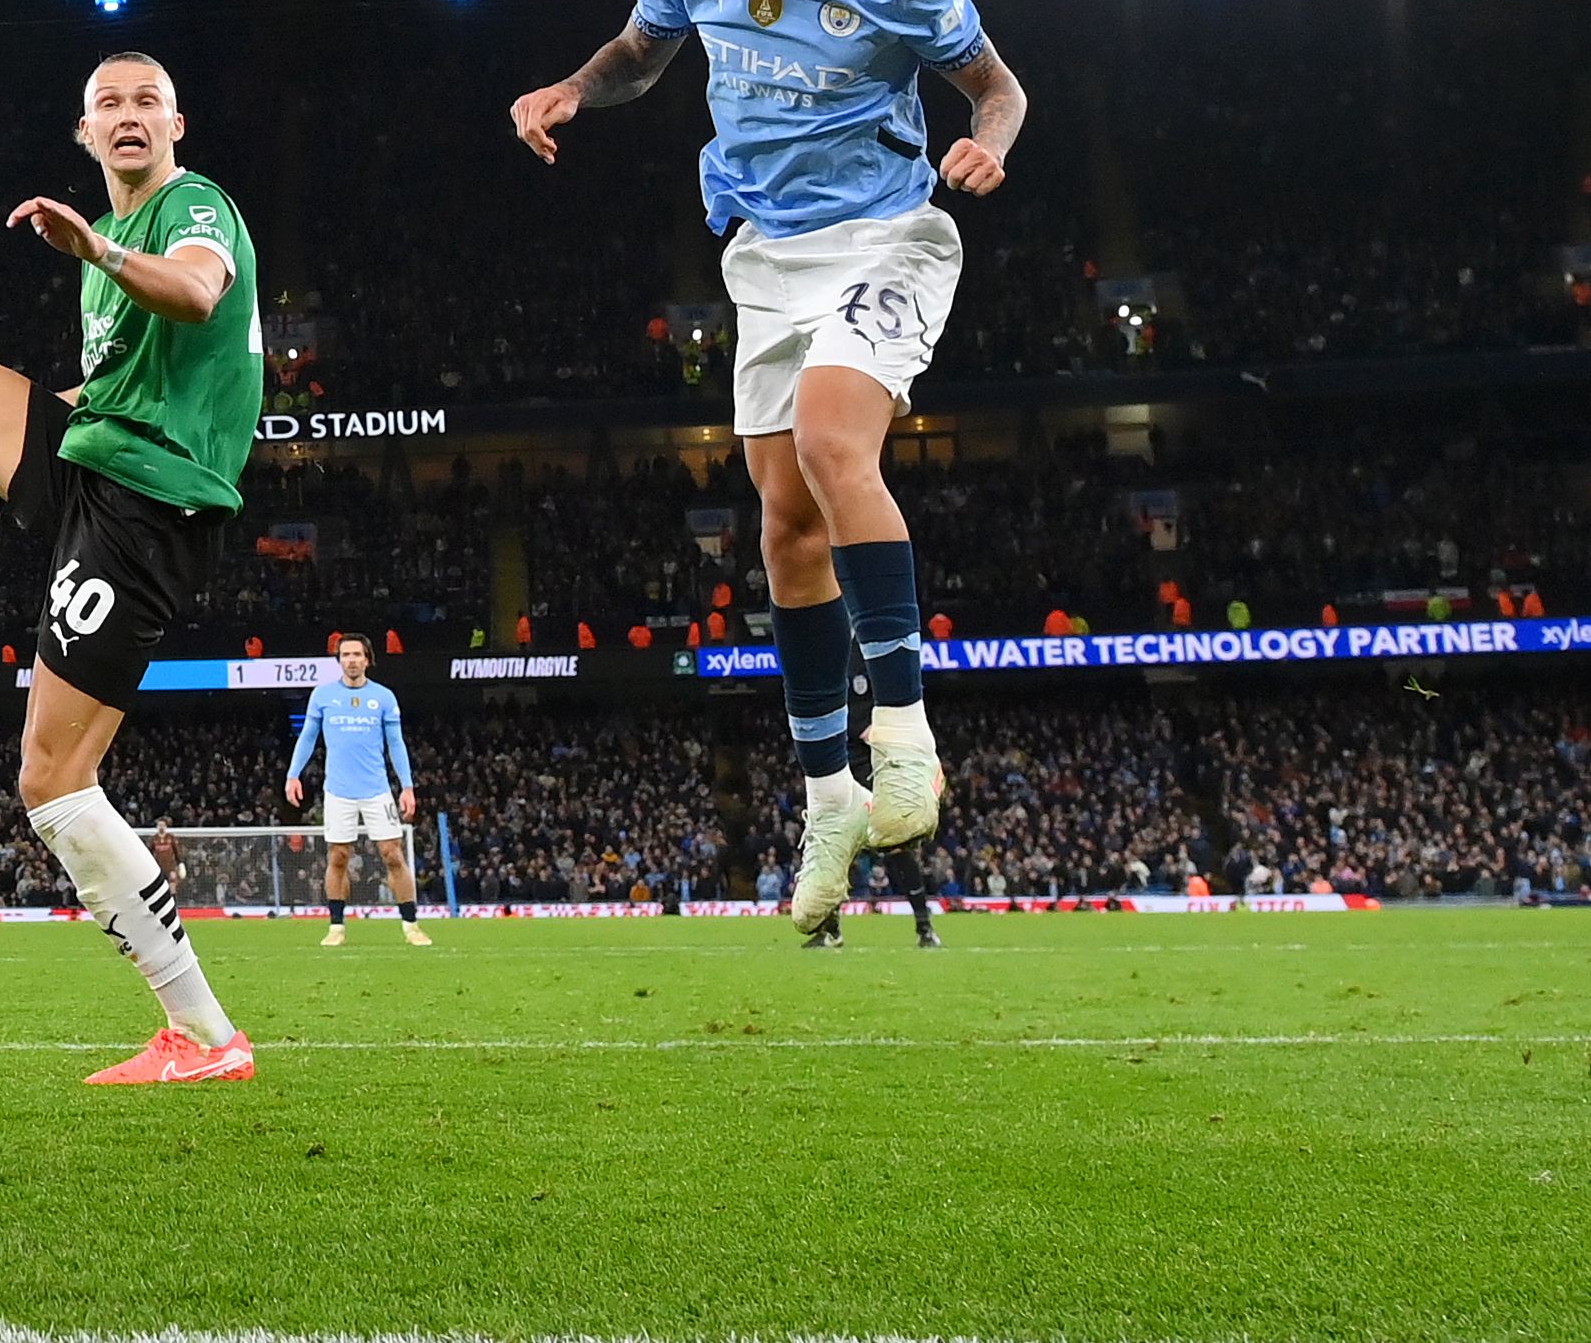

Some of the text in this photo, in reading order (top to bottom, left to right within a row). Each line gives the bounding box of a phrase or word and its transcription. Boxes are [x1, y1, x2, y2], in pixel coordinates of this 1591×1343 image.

[720, 73, 814, 108] AIRWAYS
[178, 225, 230, 247] VERTU
[836, 282, 908, 340] 75
[309, 409, 446, 439] STADIUM
[50, 559, 115, 635] 40
[963, 638, 1087, 668] WATER
[1092, 630, 1340, 664] TECHNOLOGY
[1348, 622, 1518, 656] PARTNER
[1541, 618, 1591, 650] xyle
[236, 663, 318, 683] 1 75:22
[450, 656, 579, 679] PLYMOUTH ARGYLE
[706, 647, 778, 675] xylem
